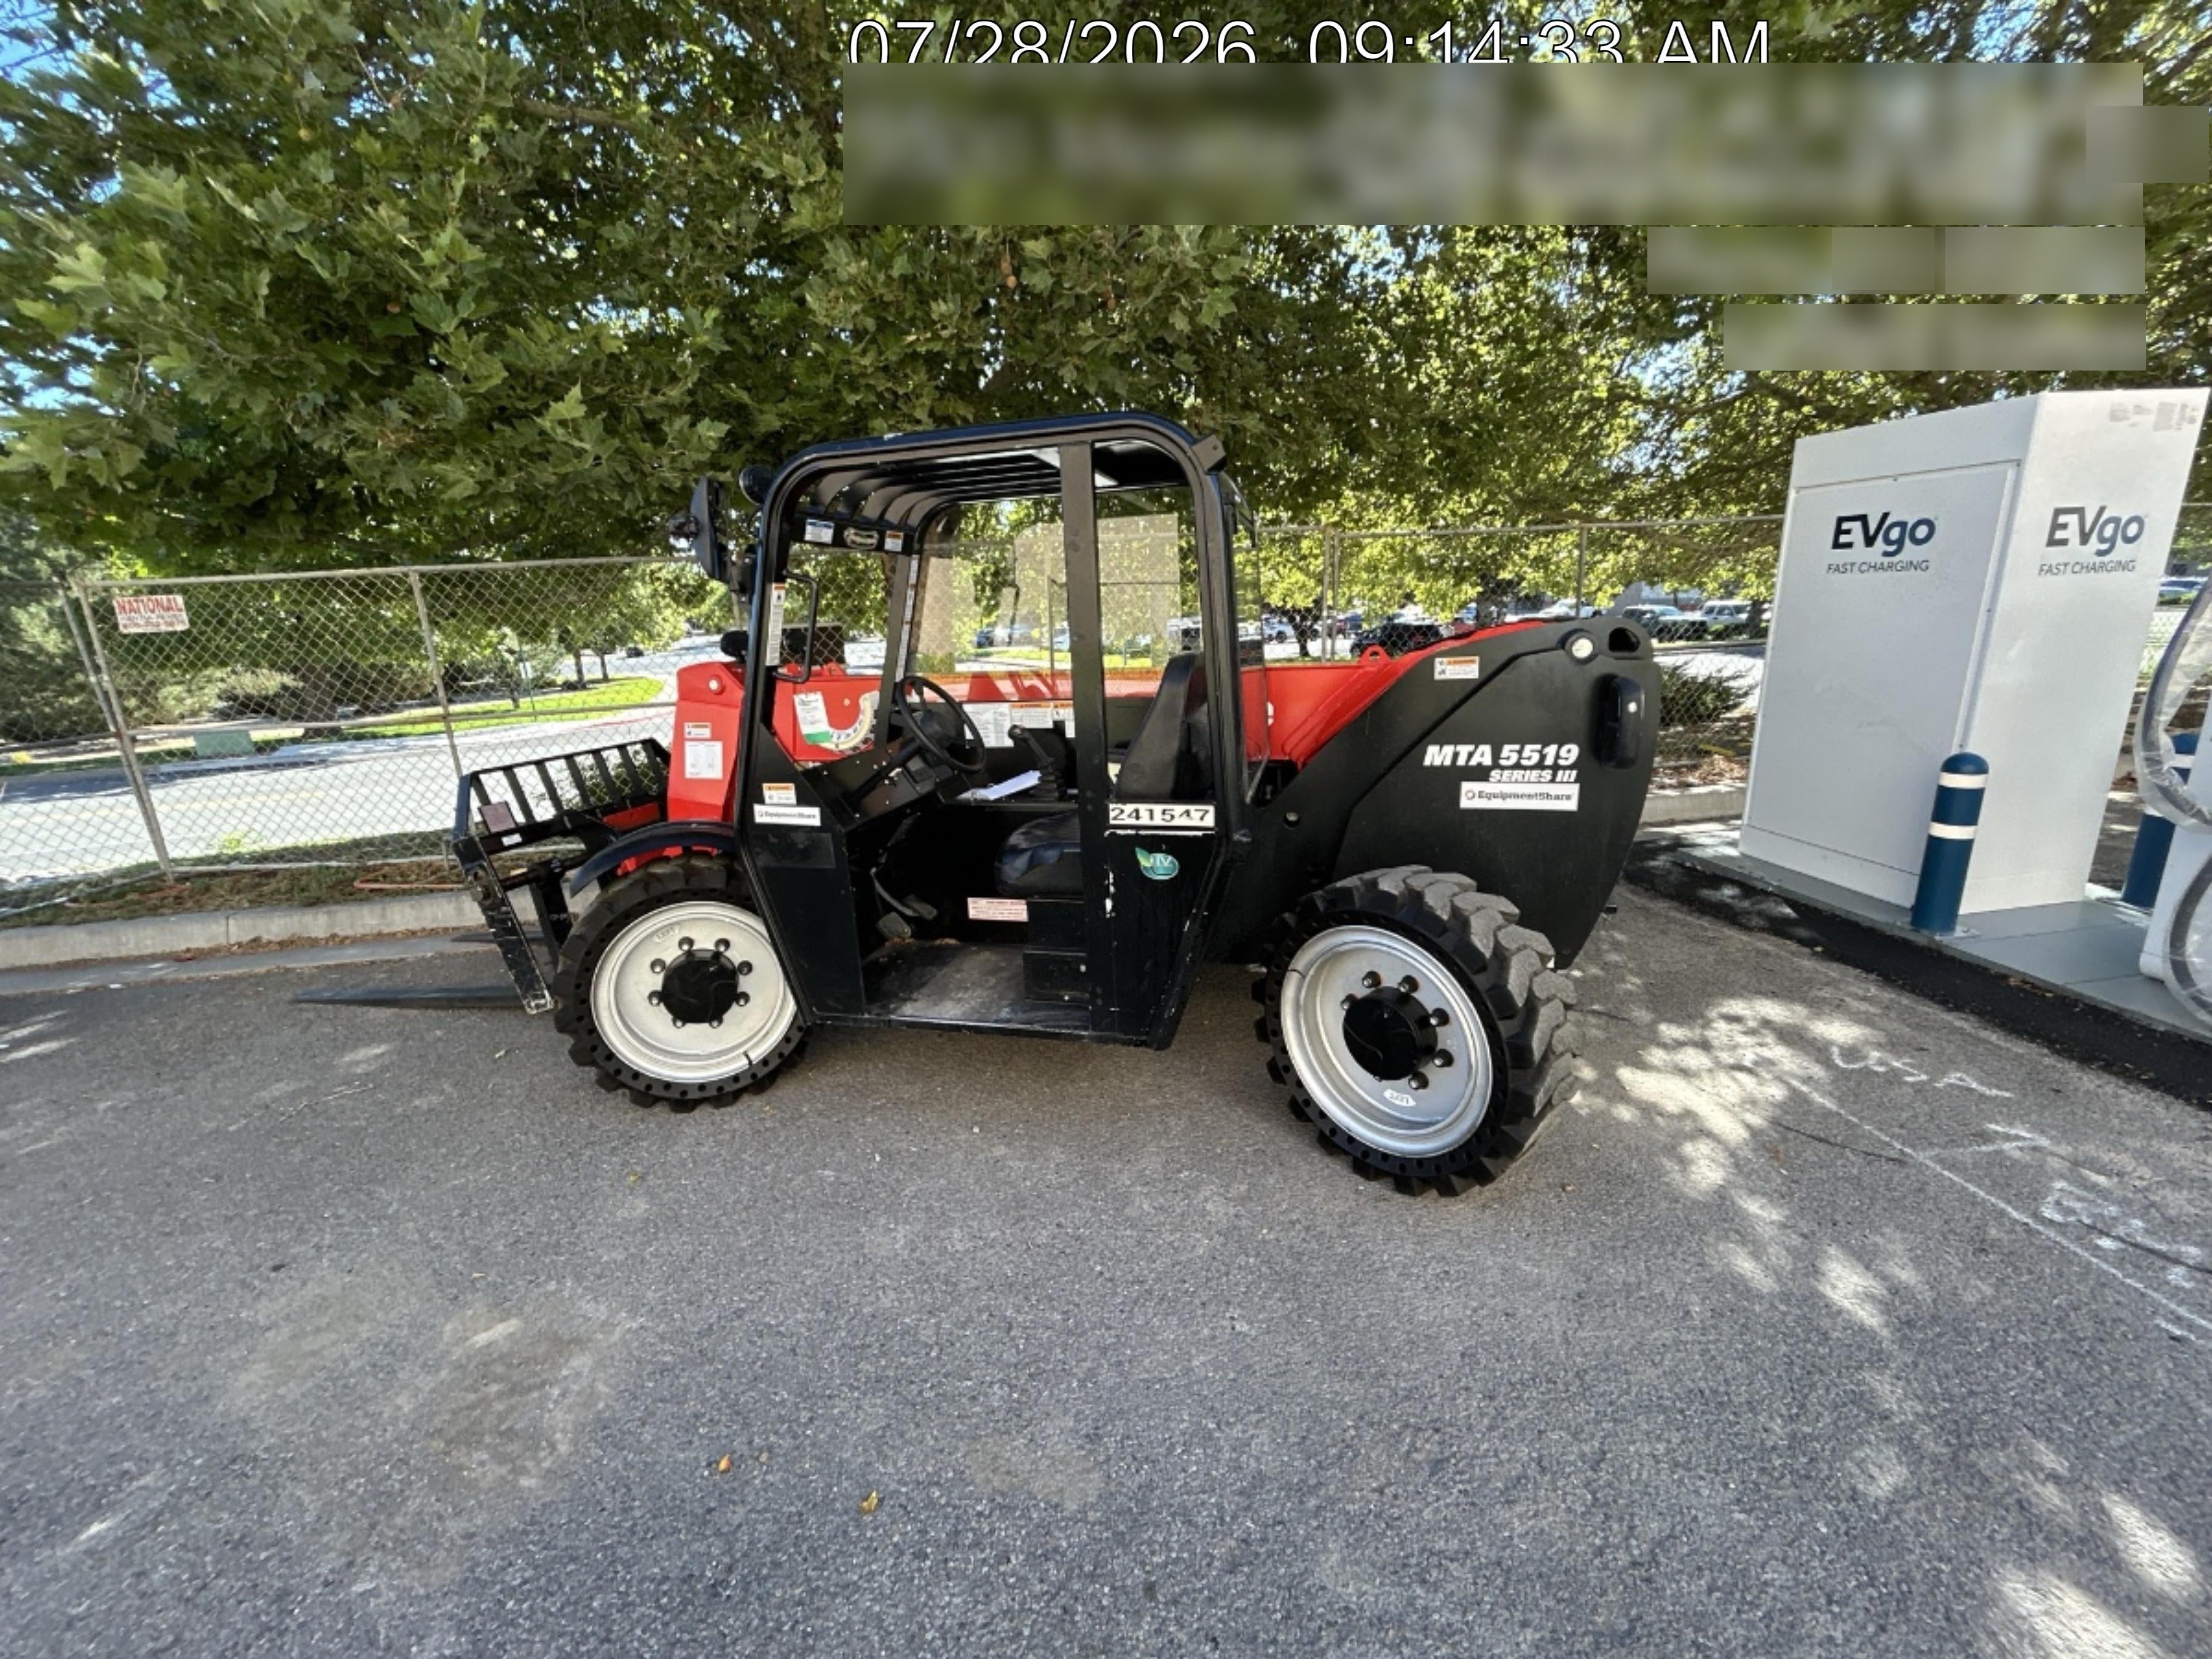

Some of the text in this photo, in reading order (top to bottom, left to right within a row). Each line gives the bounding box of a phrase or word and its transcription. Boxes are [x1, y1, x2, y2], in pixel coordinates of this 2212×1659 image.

[1831, 511, 1936, 557] EVgo
[2045, 505, 2145, 557] EVgo
[1826, 559, 1930, 575] FAST CHARGING
[2038, 559, 2136, 576] FAST CHARGING
[116, 597, 183, 614] NATIONAL
[1422, 742, 1580, 766] MTA 5519
[1488, 769, 1578, 783] SERIES III
[1478, 790, 1573, 801] EquipmentShare
[1110, 807, 1210, 822] 241547
